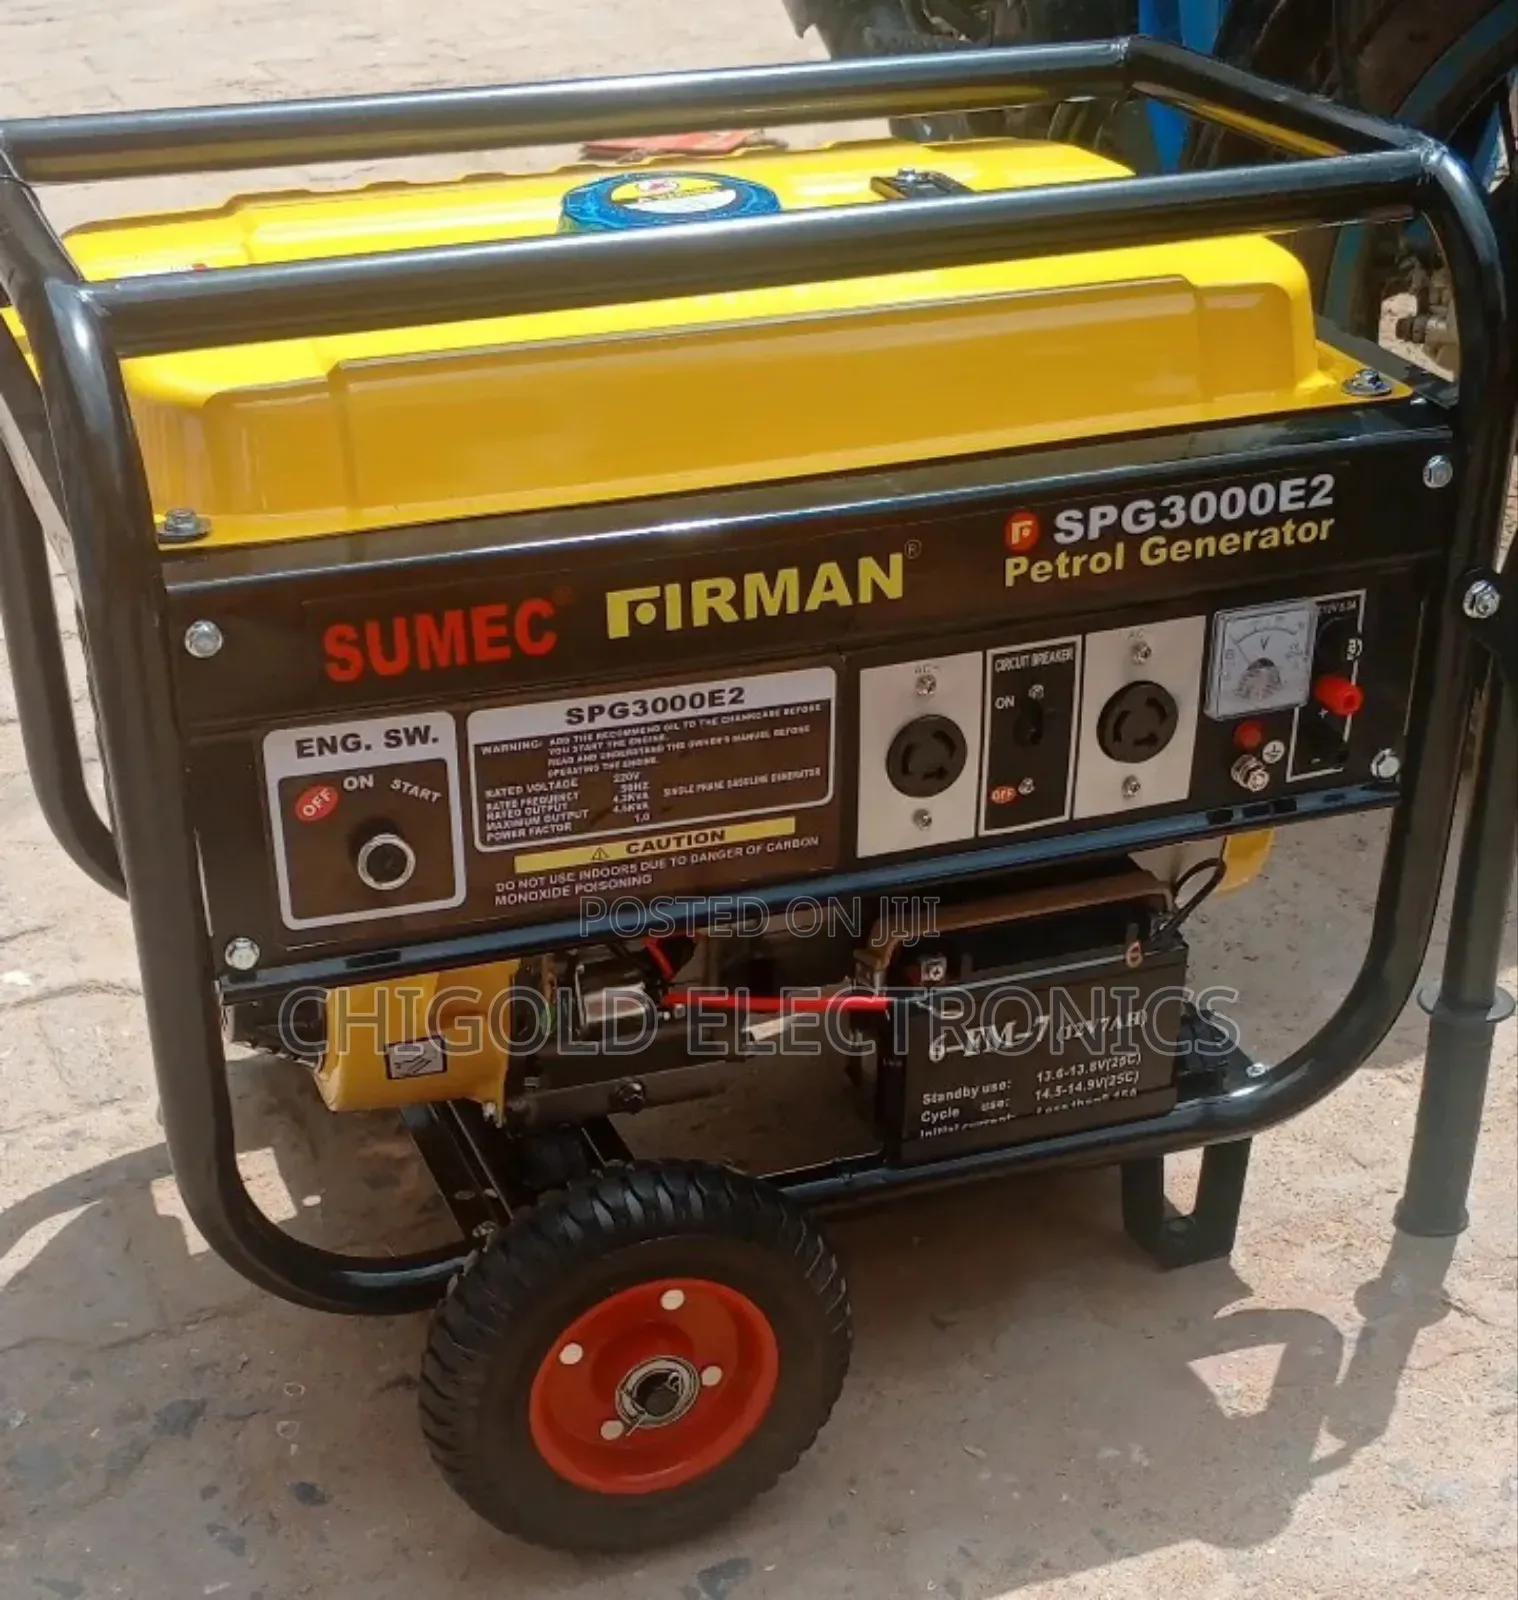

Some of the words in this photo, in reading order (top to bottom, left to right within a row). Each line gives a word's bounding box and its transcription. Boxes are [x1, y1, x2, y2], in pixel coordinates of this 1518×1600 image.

[1054, 474, 1335, 545] SPG3000E2
[1004, 542, 1124, 587] Petrol
[1140, 518, 1335, 566] Generator
[322, 598, 558, 682] SUMEC
[995, 654, 1030, 673] CIRCUIT
[1031, 647, 1074, 667] BREAKER
[566, 686, 745, 726] SPG3000E2
[995, 696, 1015, 709] ON
[295, 732, 372, 759] ENG.
[384, 725, 439, 750] SW.
[573, 732, 593, 743] THE
[596, 726, 661, 740] RECOMMEND
[683, 720, 697, 730] TO
[700, 717, 717, 727] THE
[573, 743, 604, 753] START
[606, 739, 627, 750] THE
[577, 753, 597, 763] AND
[666, 741, 686, 751] THE
[343, 774, 374, 792] ON
[390, 778, 441, 804] START
[485, 785, 523, 798] RATED
[526, 778, 579, 793] VOLTAGE
[992, 788, 1014, 801] OFF
[302, 788, 333, 817] OFF
[486, 808, 522, 821] RATED
[525, 803, 569, 816] OUTPUT
[486, 816, 541, 831] MAXIMUM
[543, 808, 590, 823] OUTPUT
[486, 829, 526, 842] POWER
[529, 822, 573, 836] FACTOR
[625, 829, 727, 856] CAUTION
[496, 881, 516, 894] DO
[518, 874, 546, 890] NOT
[549, 871, 574, 885] USE
[579, 862, 638, 880] INDOORS
[640, 859, 667, 873] DUE
[669, 856, 687, 868] TO
[690, 847, 743, 865] DANGER
[745, 845, 762, 856] OF
[766, 836, 819, 854] CARBON
[494, 886, 571, 907] MONOXIDE
[575, 874, 652, 895] POISONING
[923, 1085, 979, 1106] Standby
[982, 1079, 1012, 1094] use:
[921, 1107, 960, 1124] Cycle
[980, 1099, 1010, 1113] use:
